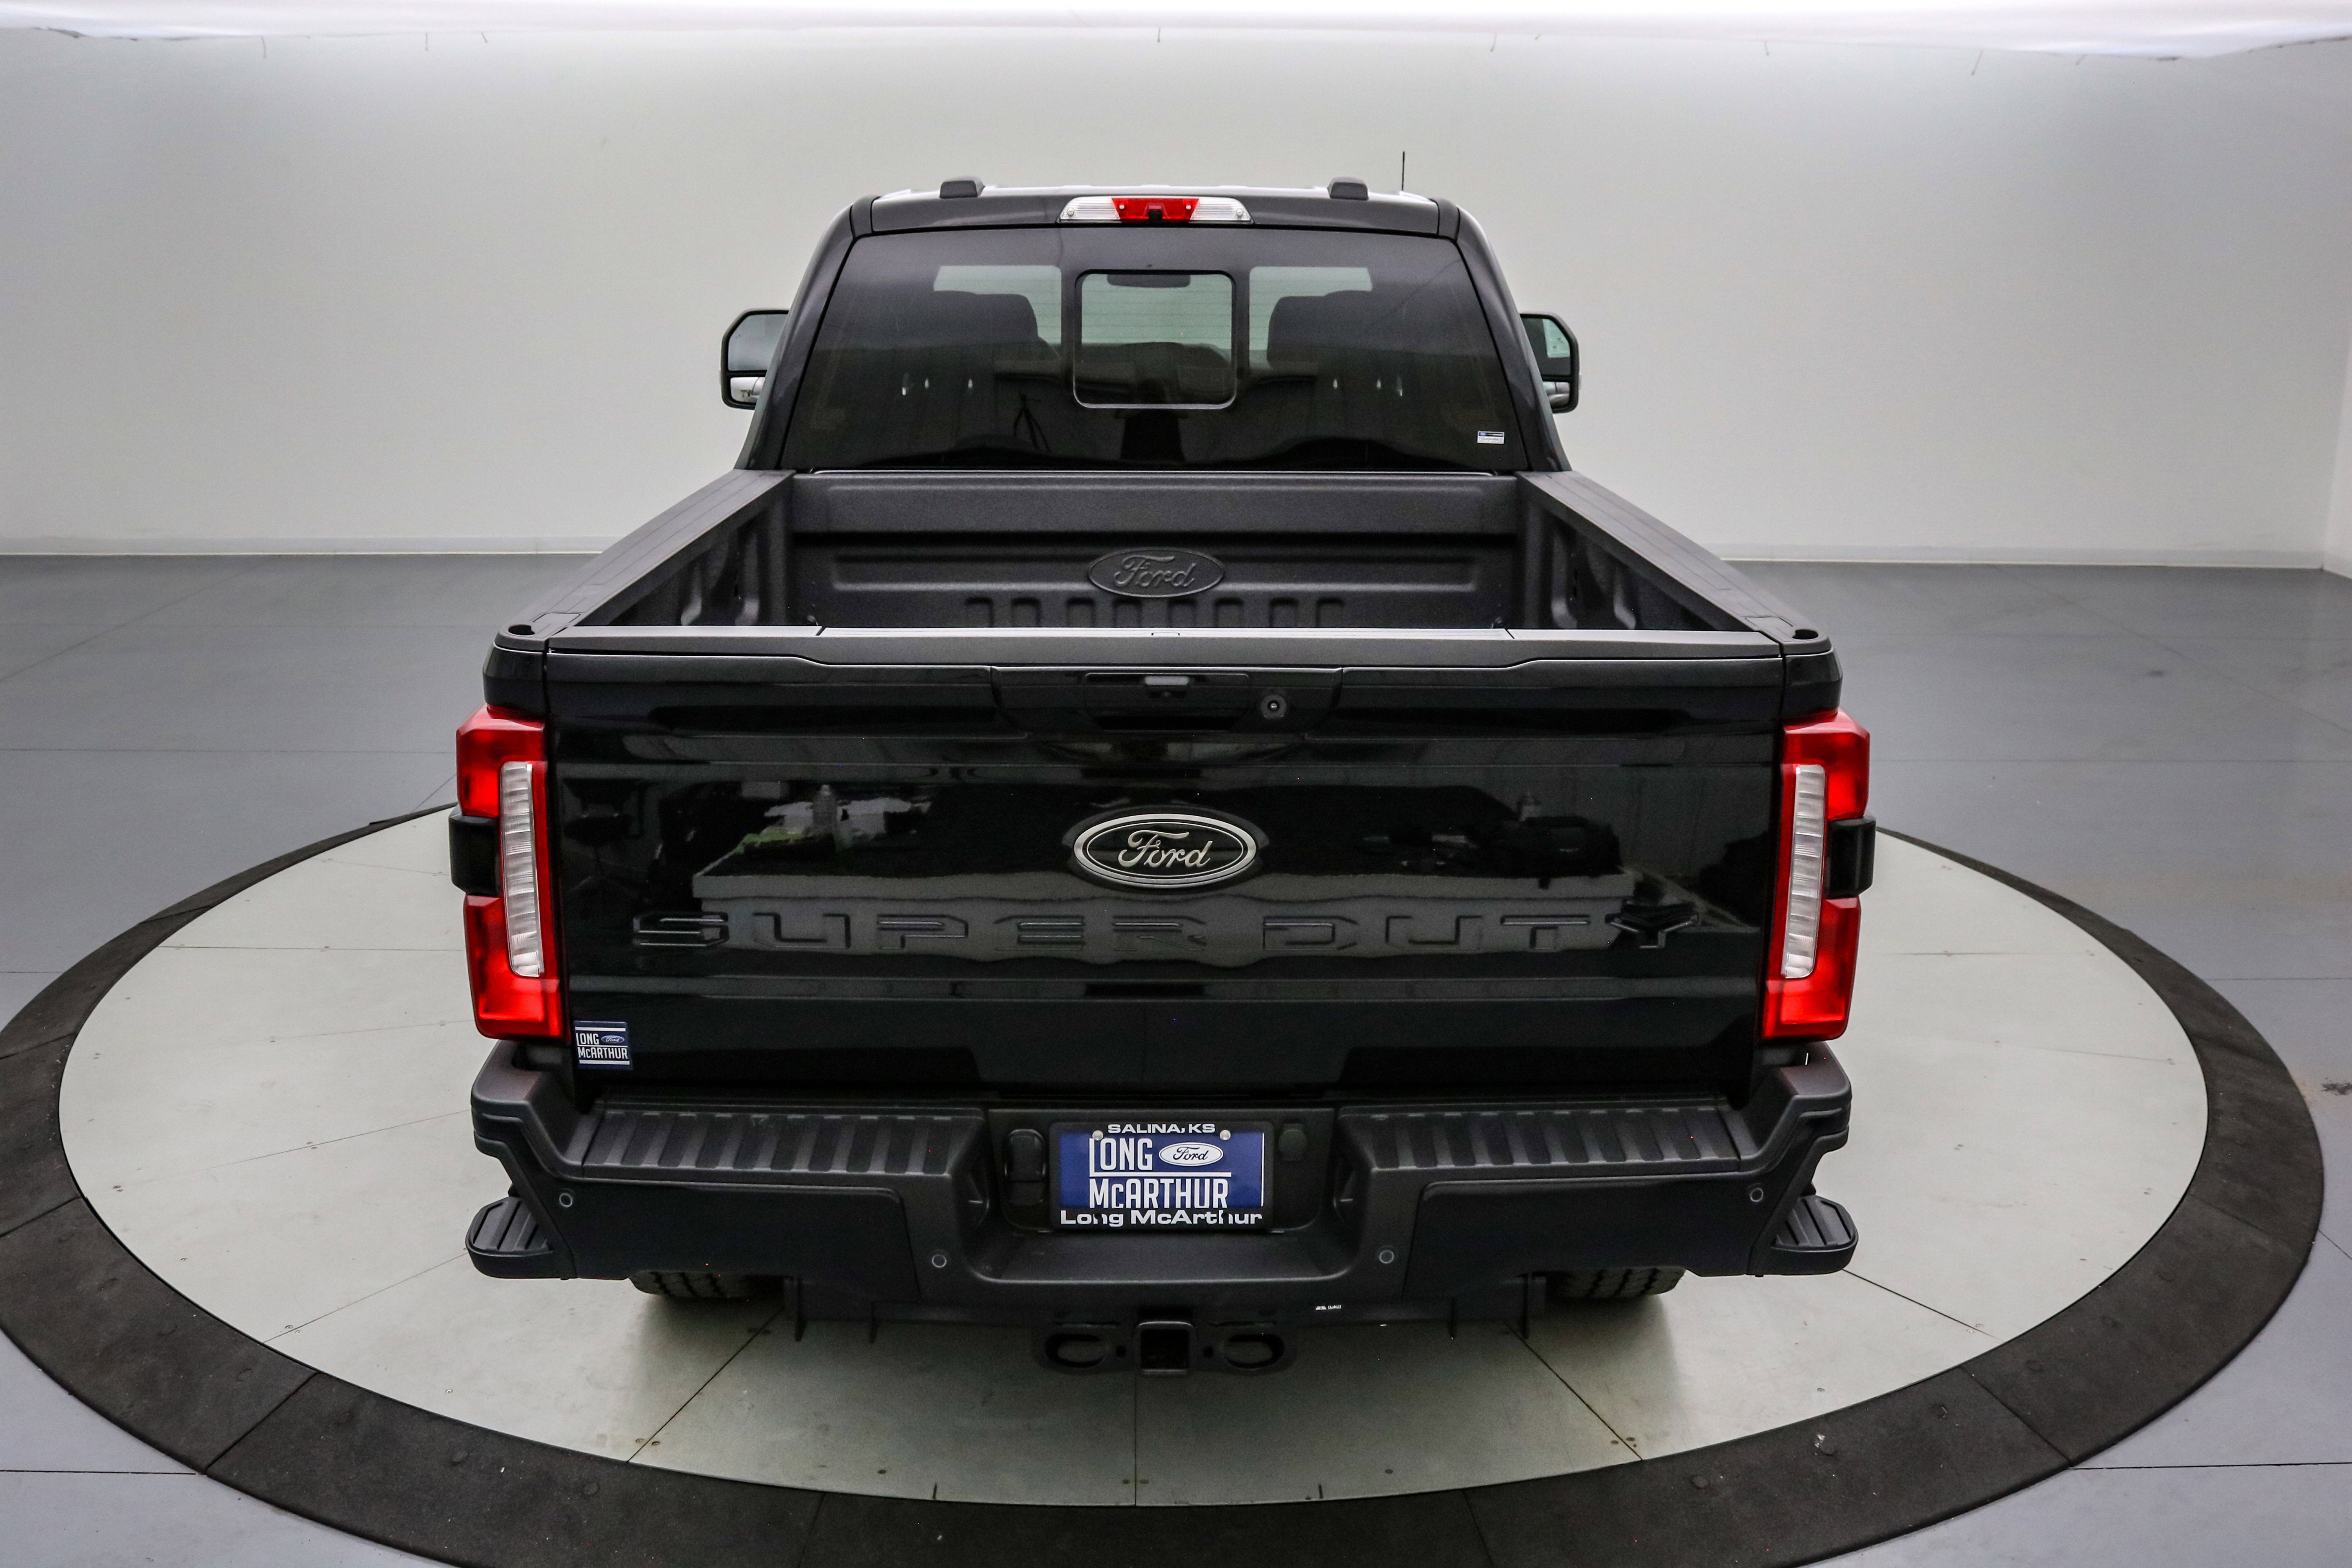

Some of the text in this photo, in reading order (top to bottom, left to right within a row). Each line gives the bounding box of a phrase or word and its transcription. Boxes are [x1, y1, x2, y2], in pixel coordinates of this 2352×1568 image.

[1114, 554, 1196, 587] Ford
[1118, 829, 1213, 867] Ford
[633, 911, 1207, 952] SUPER
[576, 1033, 599, 1046] LONG
[577, 1047, 628, 1059] McARTHUR
[1089, 1138, 1153, 1177] LONG
[1173, 1146, 1209, 1160] Ford
[1089, 1178, 1229, 1209] McARTHUR
[1060, 1209, 1263, 1227] Long McArthur
